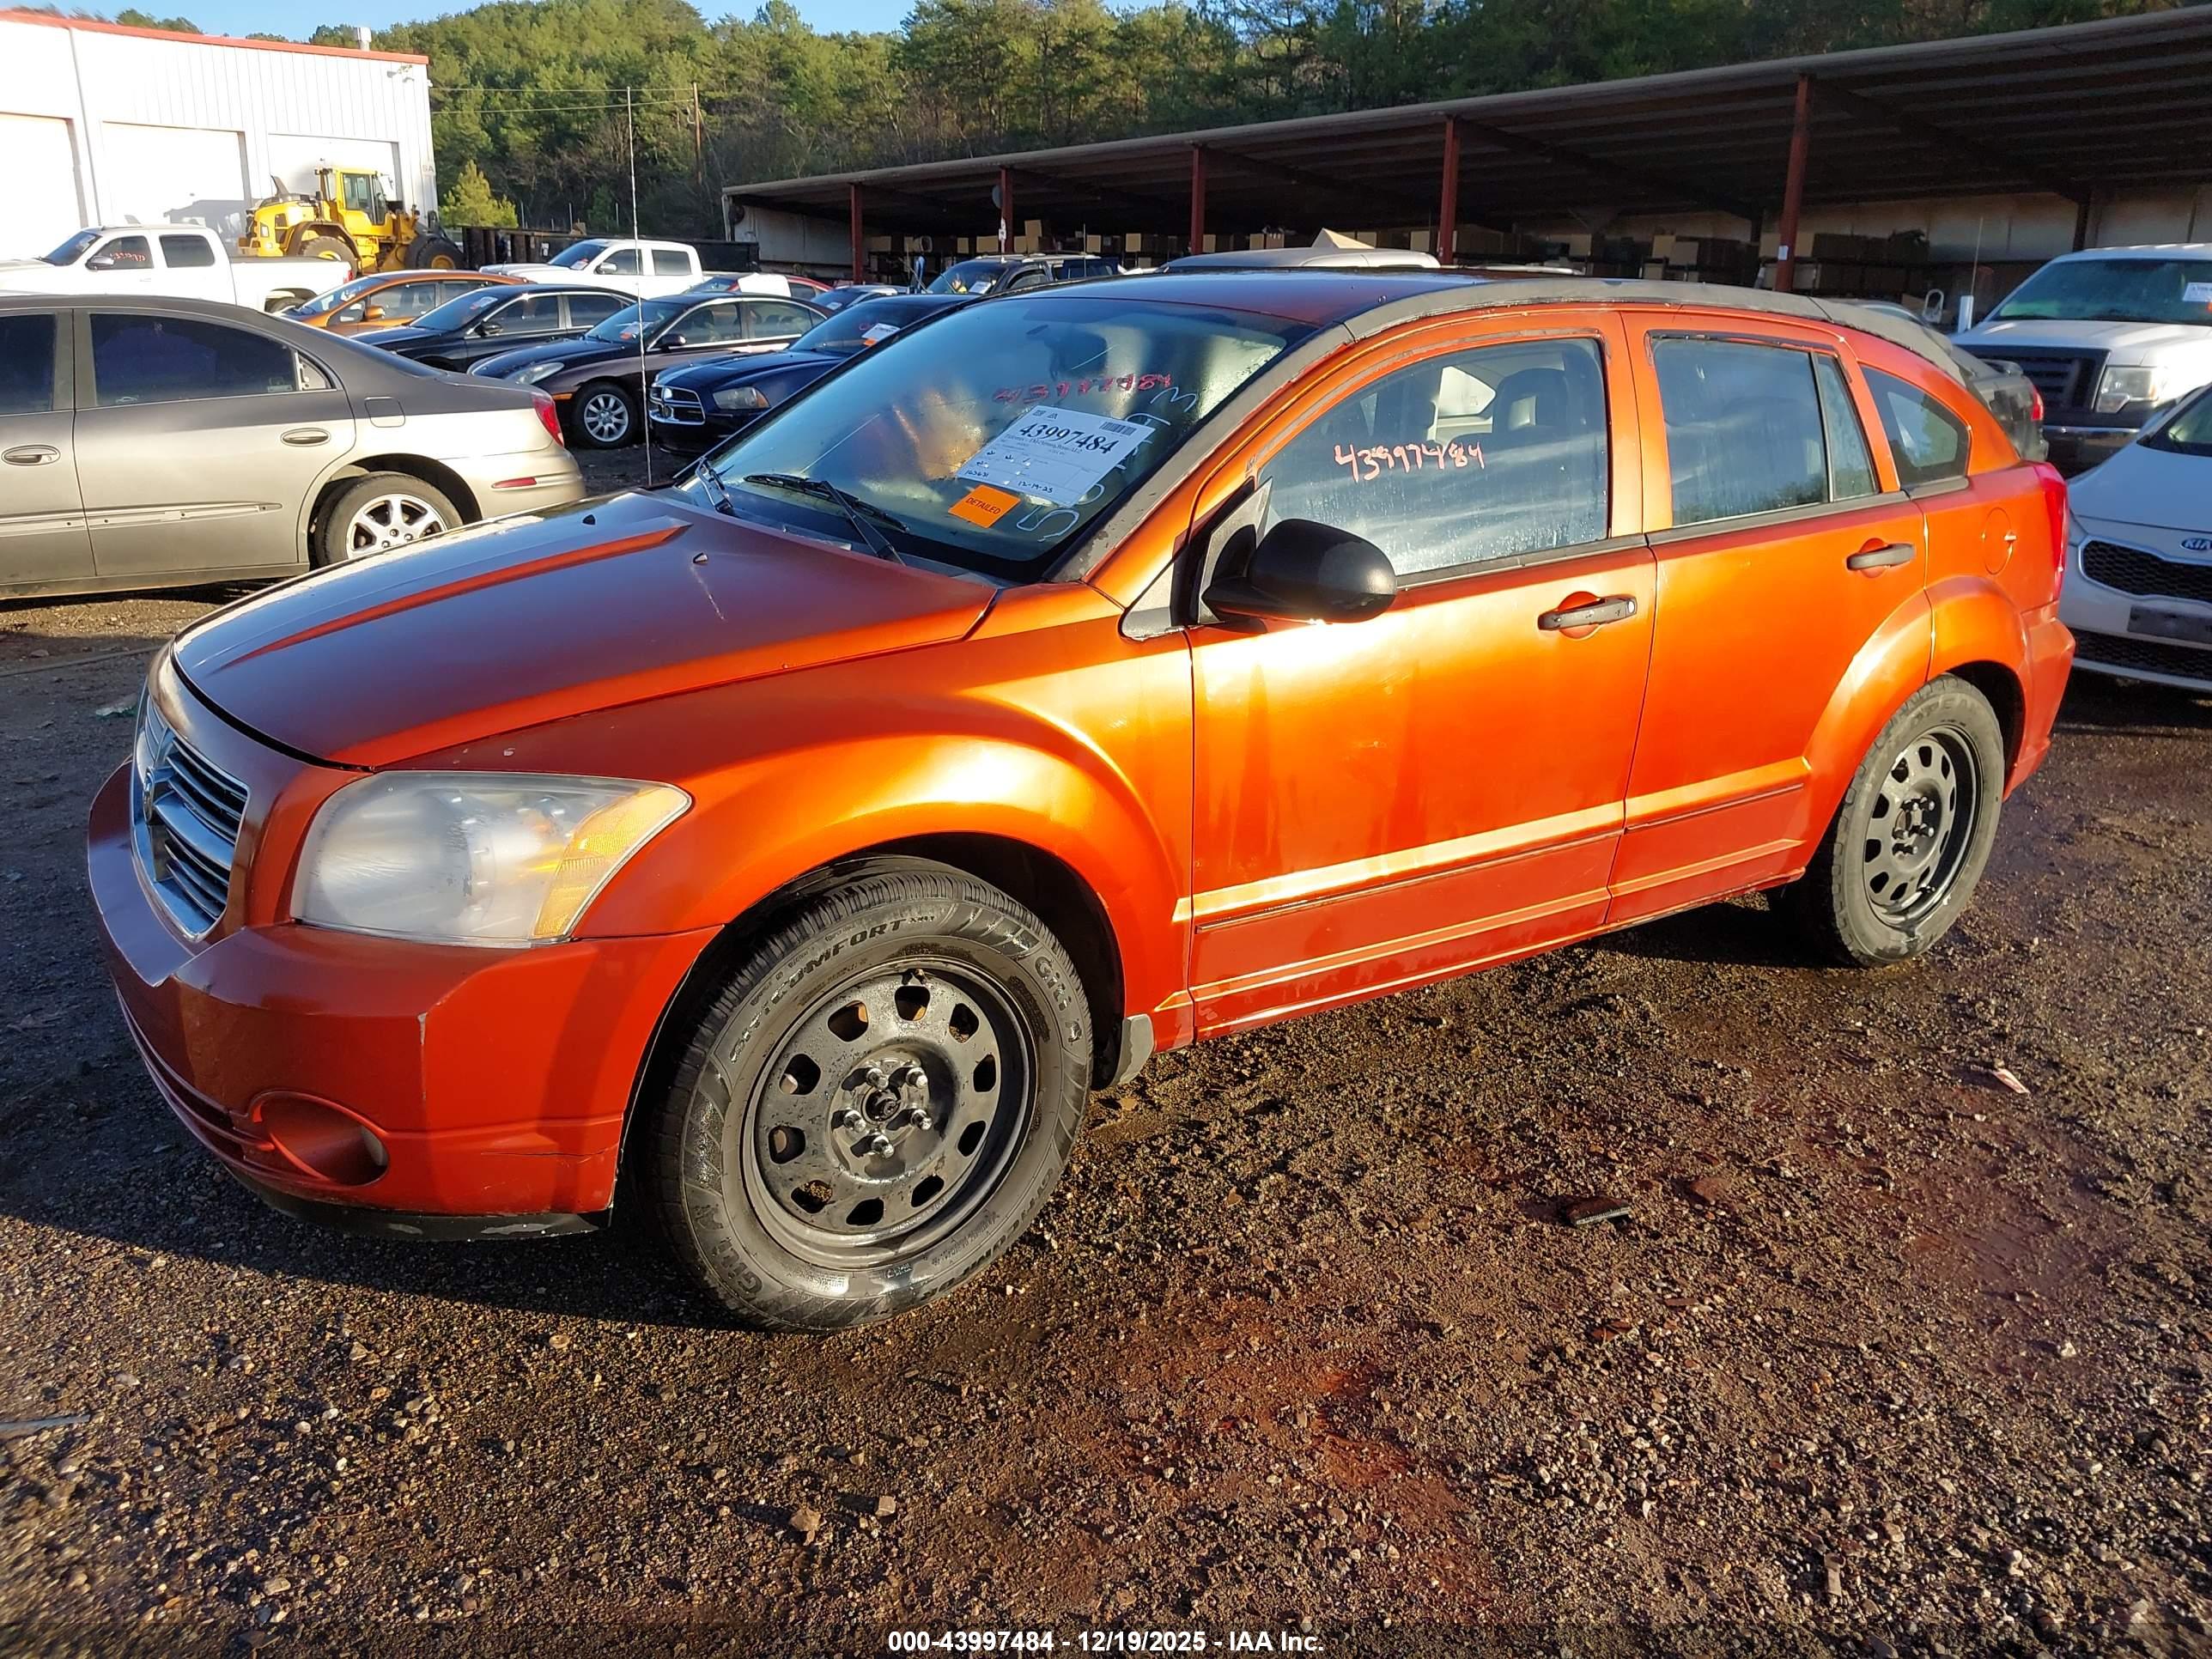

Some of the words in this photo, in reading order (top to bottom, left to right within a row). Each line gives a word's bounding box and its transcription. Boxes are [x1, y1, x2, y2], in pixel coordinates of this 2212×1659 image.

[1018, 422, 1120, 454] 43997484
[1334, 441, 1485, 483] 43997484
[964, 496, 1003, 515] DETAILED
[2185, 538, 2211, 550] KIA
